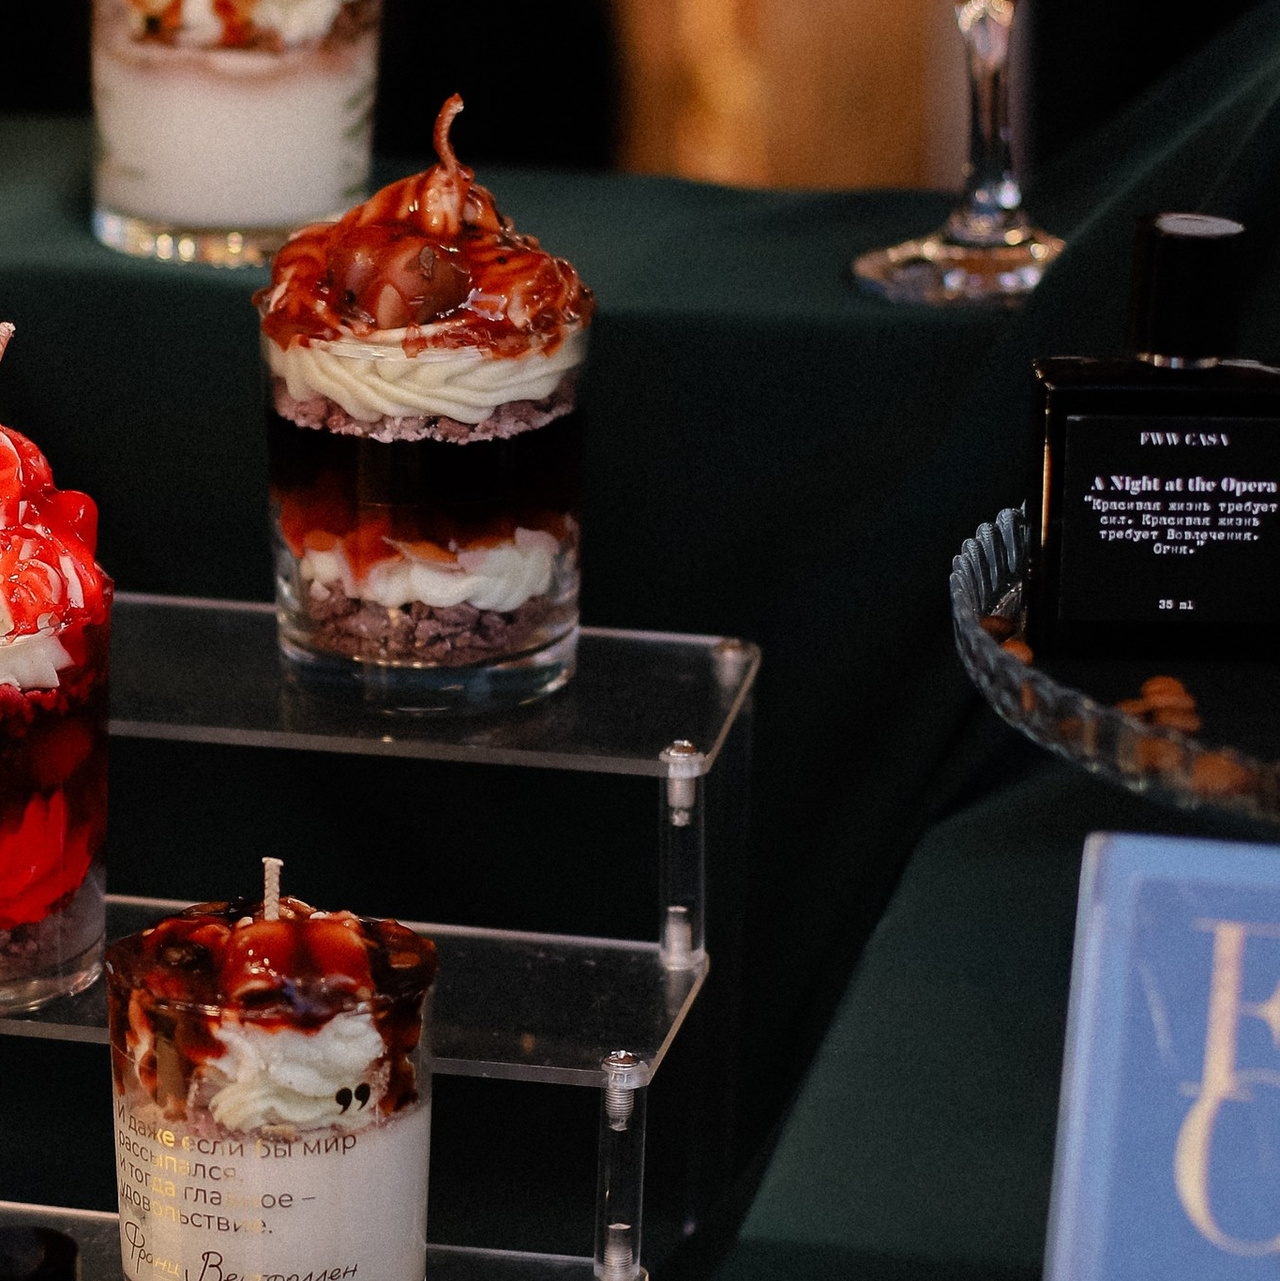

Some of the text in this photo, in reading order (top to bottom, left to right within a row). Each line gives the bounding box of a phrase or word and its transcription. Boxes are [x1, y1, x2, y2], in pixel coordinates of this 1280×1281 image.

[1184, 432, 1230, 446] CASA
[1090, 475, 1278, 497] A Night at the Opera
[1168, 501, 1211, 512] жизнь
[1218, 501, 1278, 514] требует
[1099, 513, 1261, 528] сил. Красивая жизнь
[1098, 528, 1260, 542] требует Вовлечения.
[1158, 599, 1194, 610] 35 ml
[116, 1100, 126, 1124] И
[128, 1115, 176, 1148] даже
[181, 1135, 245, 1157] если
[303, 1133, 357, 1156] мир
[119, 1153, 127, 1168] и
[128, 1161, 176, 1197] тогда
[184, 1186, 293, 1209] глаое
